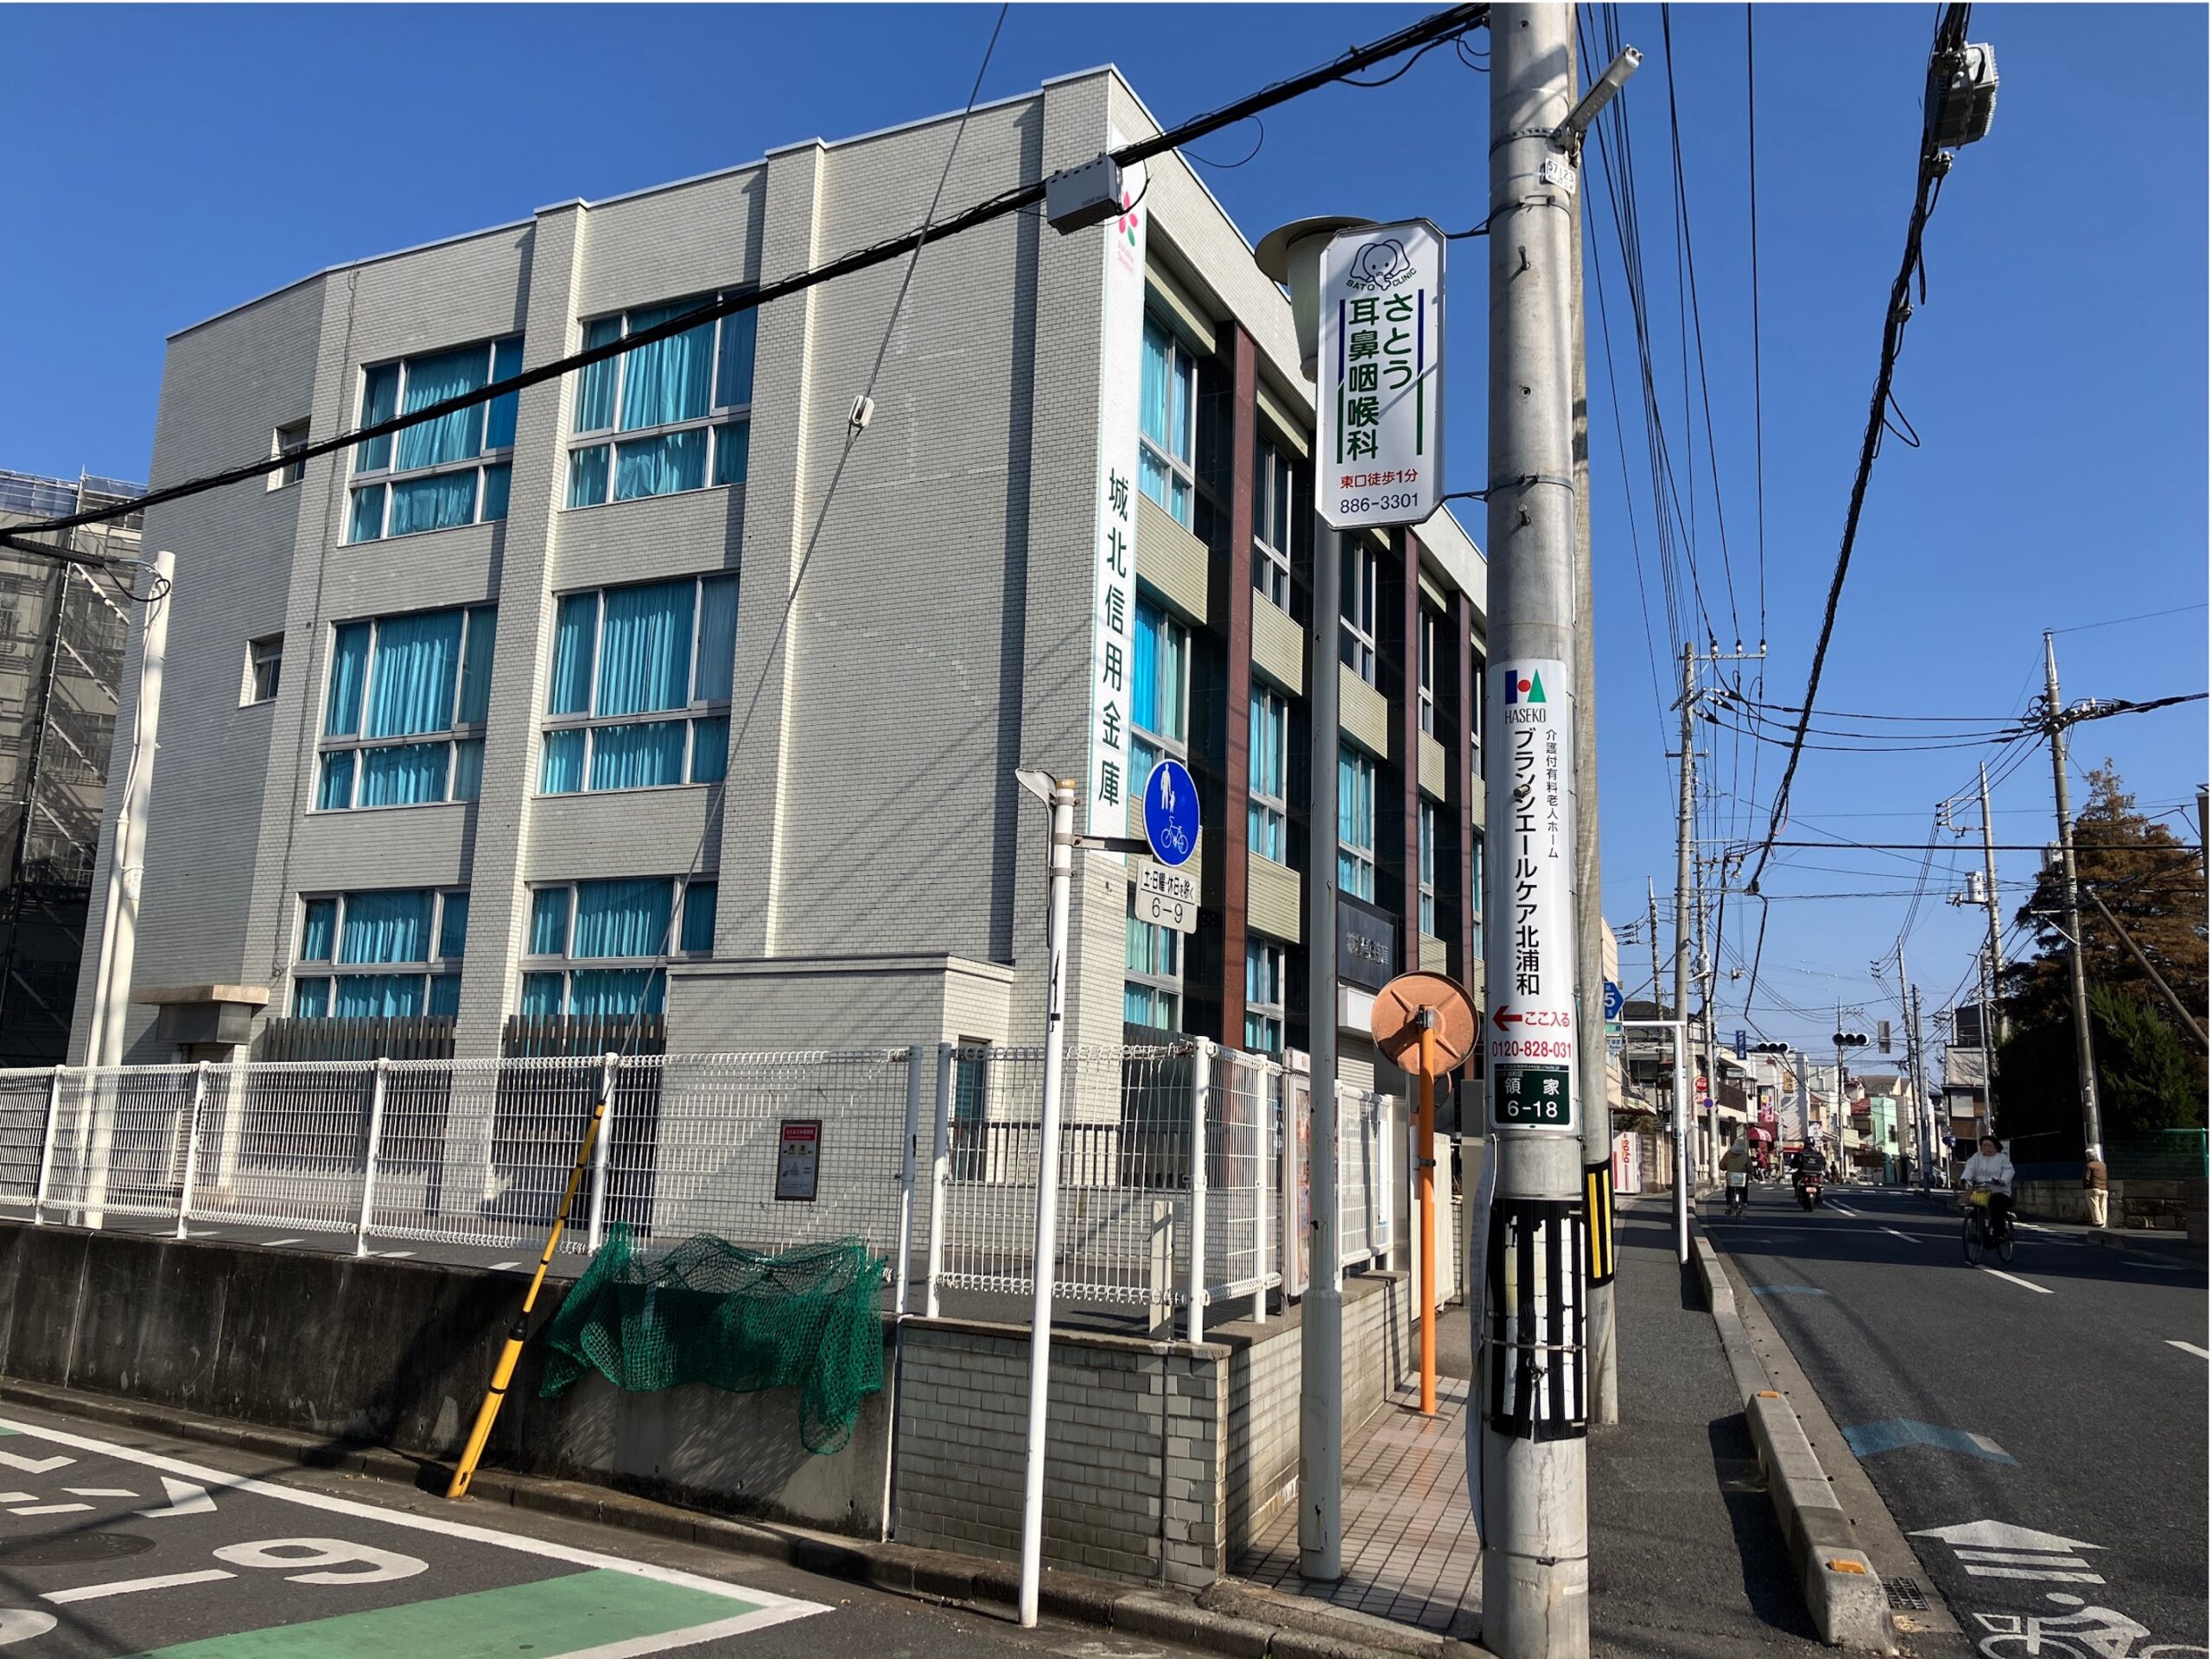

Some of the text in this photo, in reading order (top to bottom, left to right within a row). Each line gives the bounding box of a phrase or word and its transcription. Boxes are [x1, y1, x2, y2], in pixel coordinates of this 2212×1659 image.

[1346, 268, 1417, 291] SATO CLINIC
[1383, 293, 1413, 390] さとう
[1347, 297, 1380, 461] 耳鼻咽喉科
[1340, 469, 1418, 489] 東口徒歩1分
[1340, 493, 1419, 513] 886-3301
[1098, 467, 1128, 807] 城北信用金庫
[1504, 708, 1547, 724] HASEKO
[1546, 729, 1558, 859] 介護付有料老人ホーム
[1152, 897, 1183, 924] 6-9
[1525, 1011, 1570, 1027] ここ入る
[1492, 1040, 1572, 1058] 0120-828-031
[1504, 1077, 1560, 1096] 領家
[1507, 1100, 1558, 1118] 6-18
